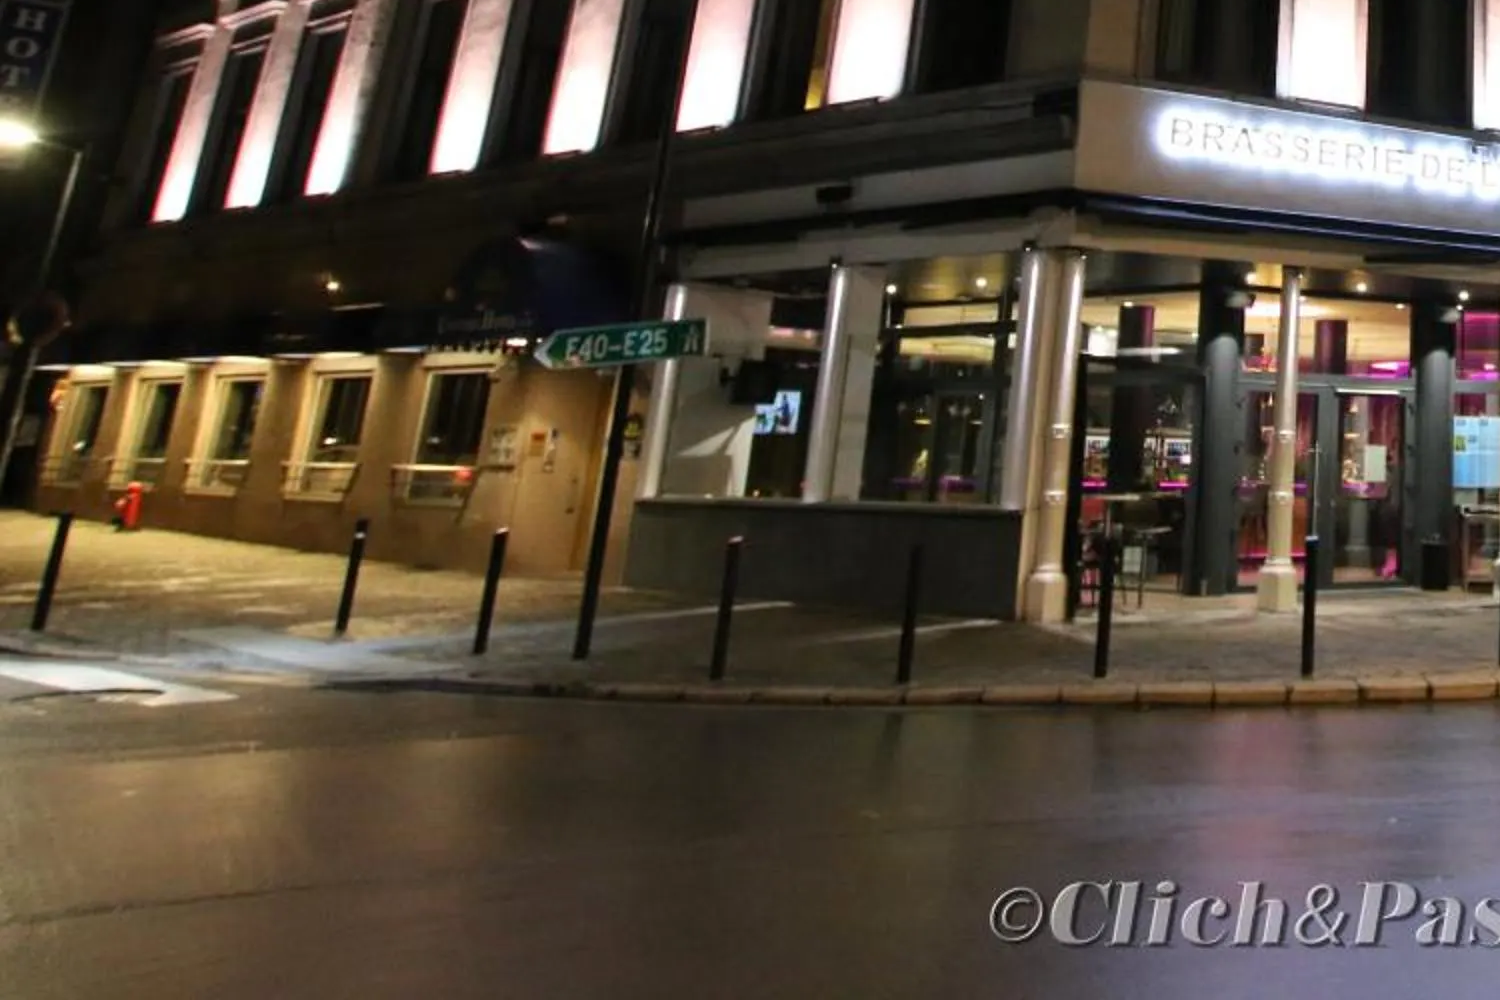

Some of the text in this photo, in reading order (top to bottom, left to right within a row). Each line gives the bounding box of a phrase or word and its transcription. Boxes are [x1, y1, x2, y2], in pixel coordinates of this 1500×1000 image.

[1169, 116, 1406, 176] BRASSERIE
[1420, 152, 1467, 186] DE
[565, 328, 668, 363] E40-E25
